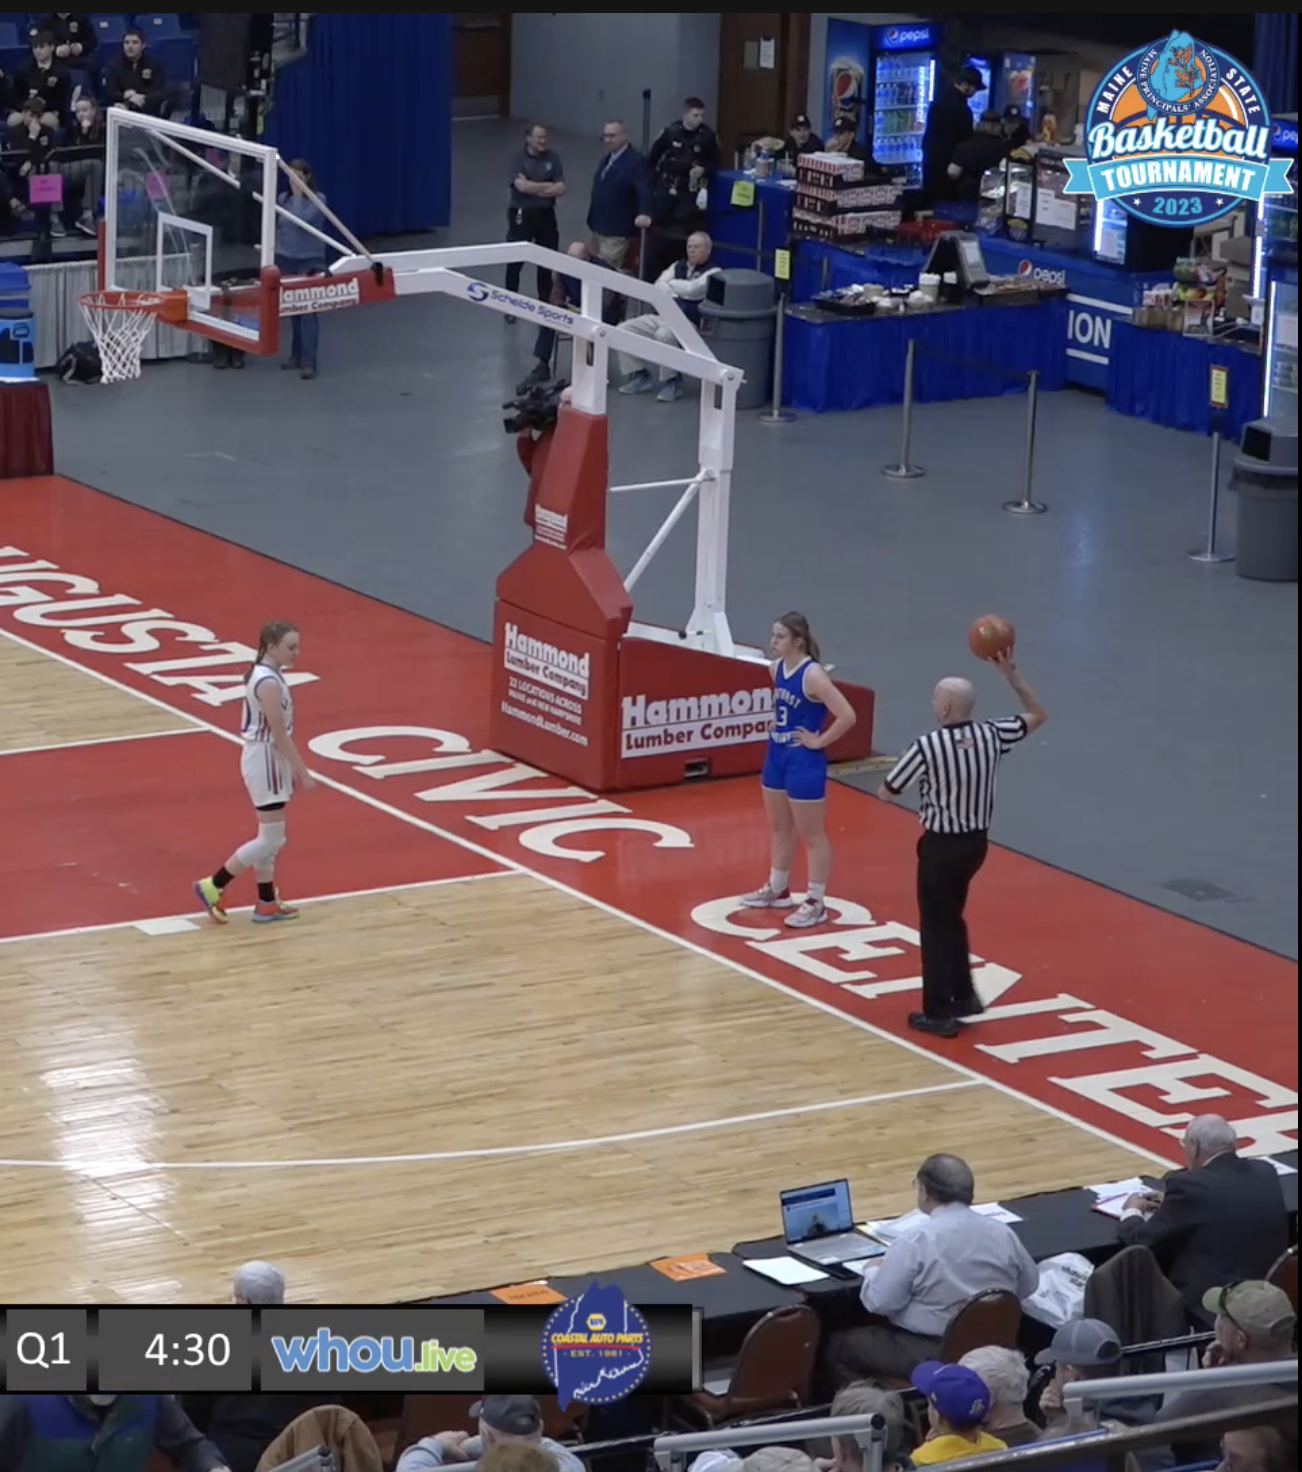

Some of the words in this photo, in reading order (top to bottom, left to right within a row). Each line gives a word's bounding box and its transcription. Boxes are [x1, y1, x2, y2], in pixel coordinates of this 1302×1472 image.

[899, 28, 930, 42] pepsi
[537, 305, 574, 325] Sports
[505, 622, 590, 679] Hammond
[506, 650, 540, 675] Lumber
[541, 665, 587, 697] Company
[622, 687, 774, 728] Hammon
[626, 728, 694, 751] Lumber
[308, 725, 696, 862] CIVIC
